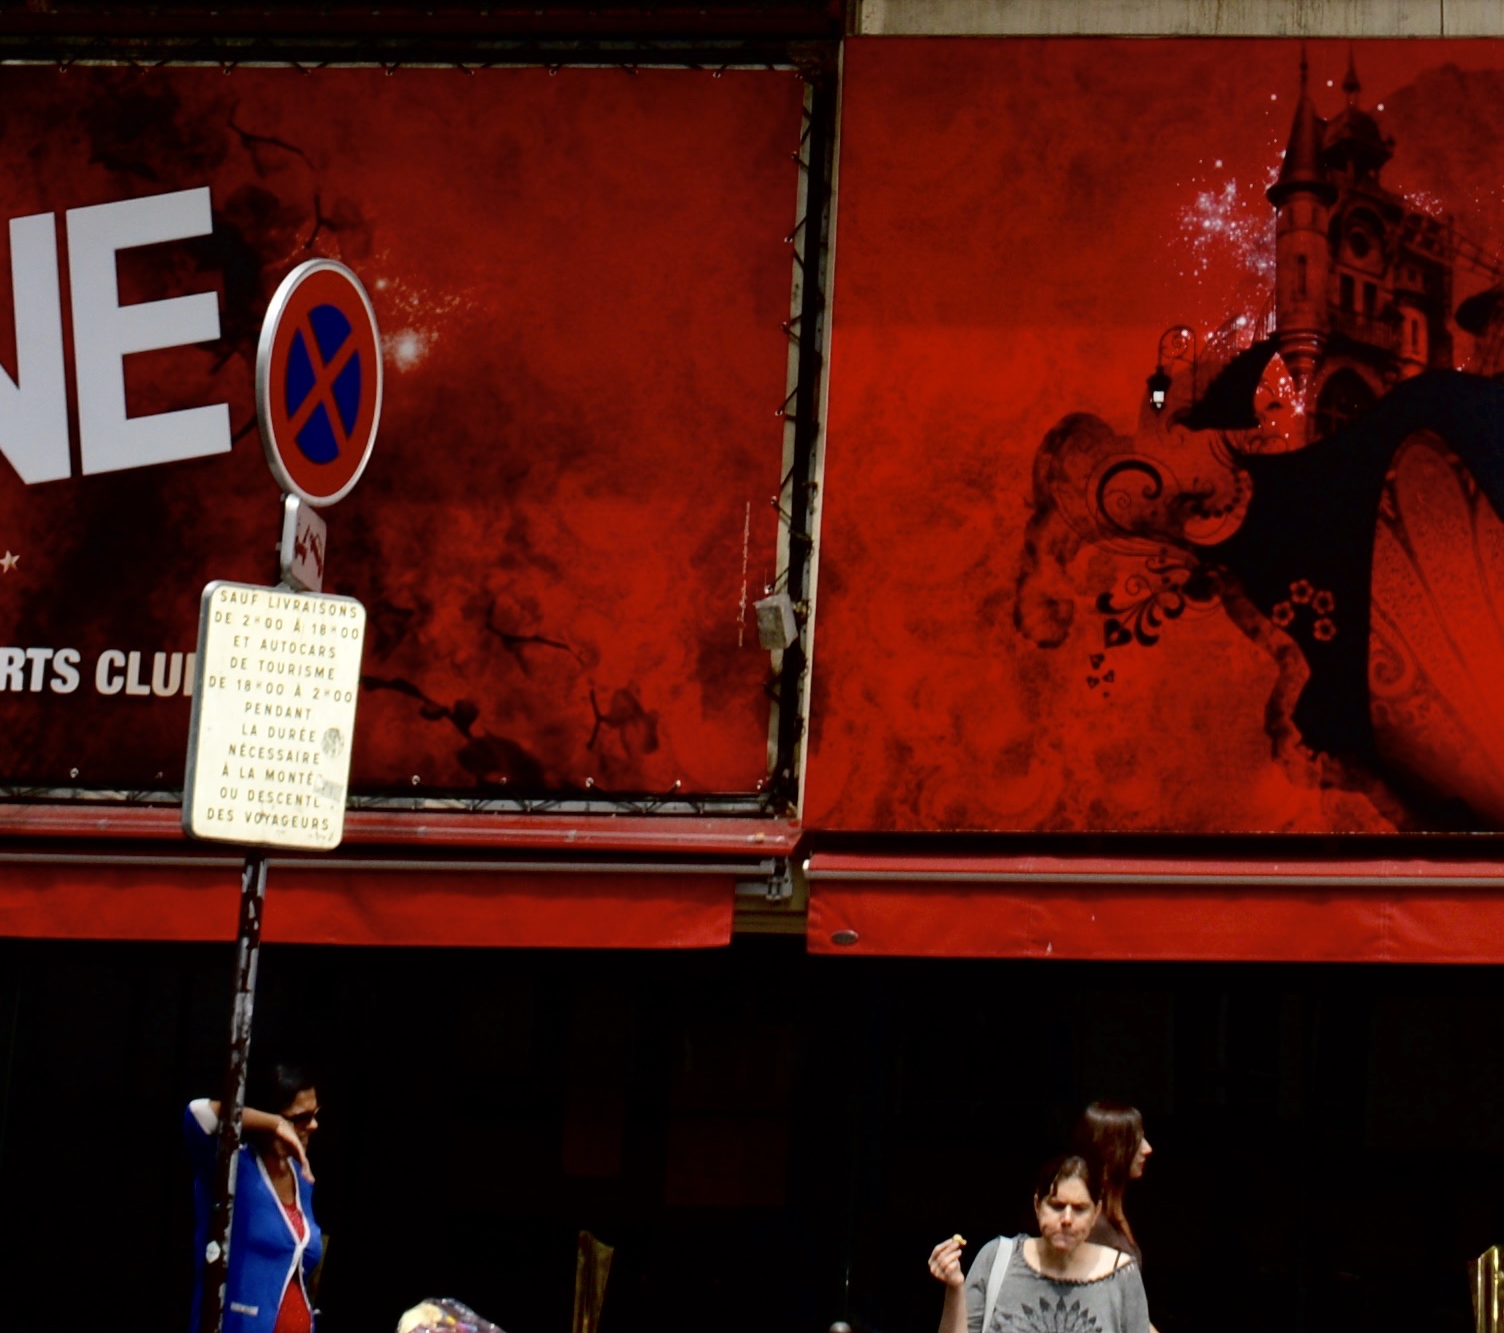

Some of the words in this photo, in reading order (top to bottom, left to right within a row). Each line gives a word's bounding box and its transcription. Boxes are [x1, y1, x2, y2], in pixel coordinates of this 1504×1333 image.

[220, 590, 258, 606] SAUF
[268, 597, 357, 619] LIVRAISONS
[214, 610, 232, 624] DE
[233, 635, 250, 648] ET
[260, 638, 336, 659] AUTOCARS
[230, 656, 247, 670] DE
[259, 659, 336, 680] TOURISME
[209, 675, 226, 689] DE
[244, 701, 312, 721] PENDANT
[242, 723, 258, 737] LA
[268, 725, 316, 742] DURÉE
[228, 743, 321, 765] NÉCESSAIRE
[239, 767, 255, 780] LA
[220, 786, 238, 800] OU
[207, 807, 234, 823] DES
[244, 810, 329, 831] VOYAGEURS
